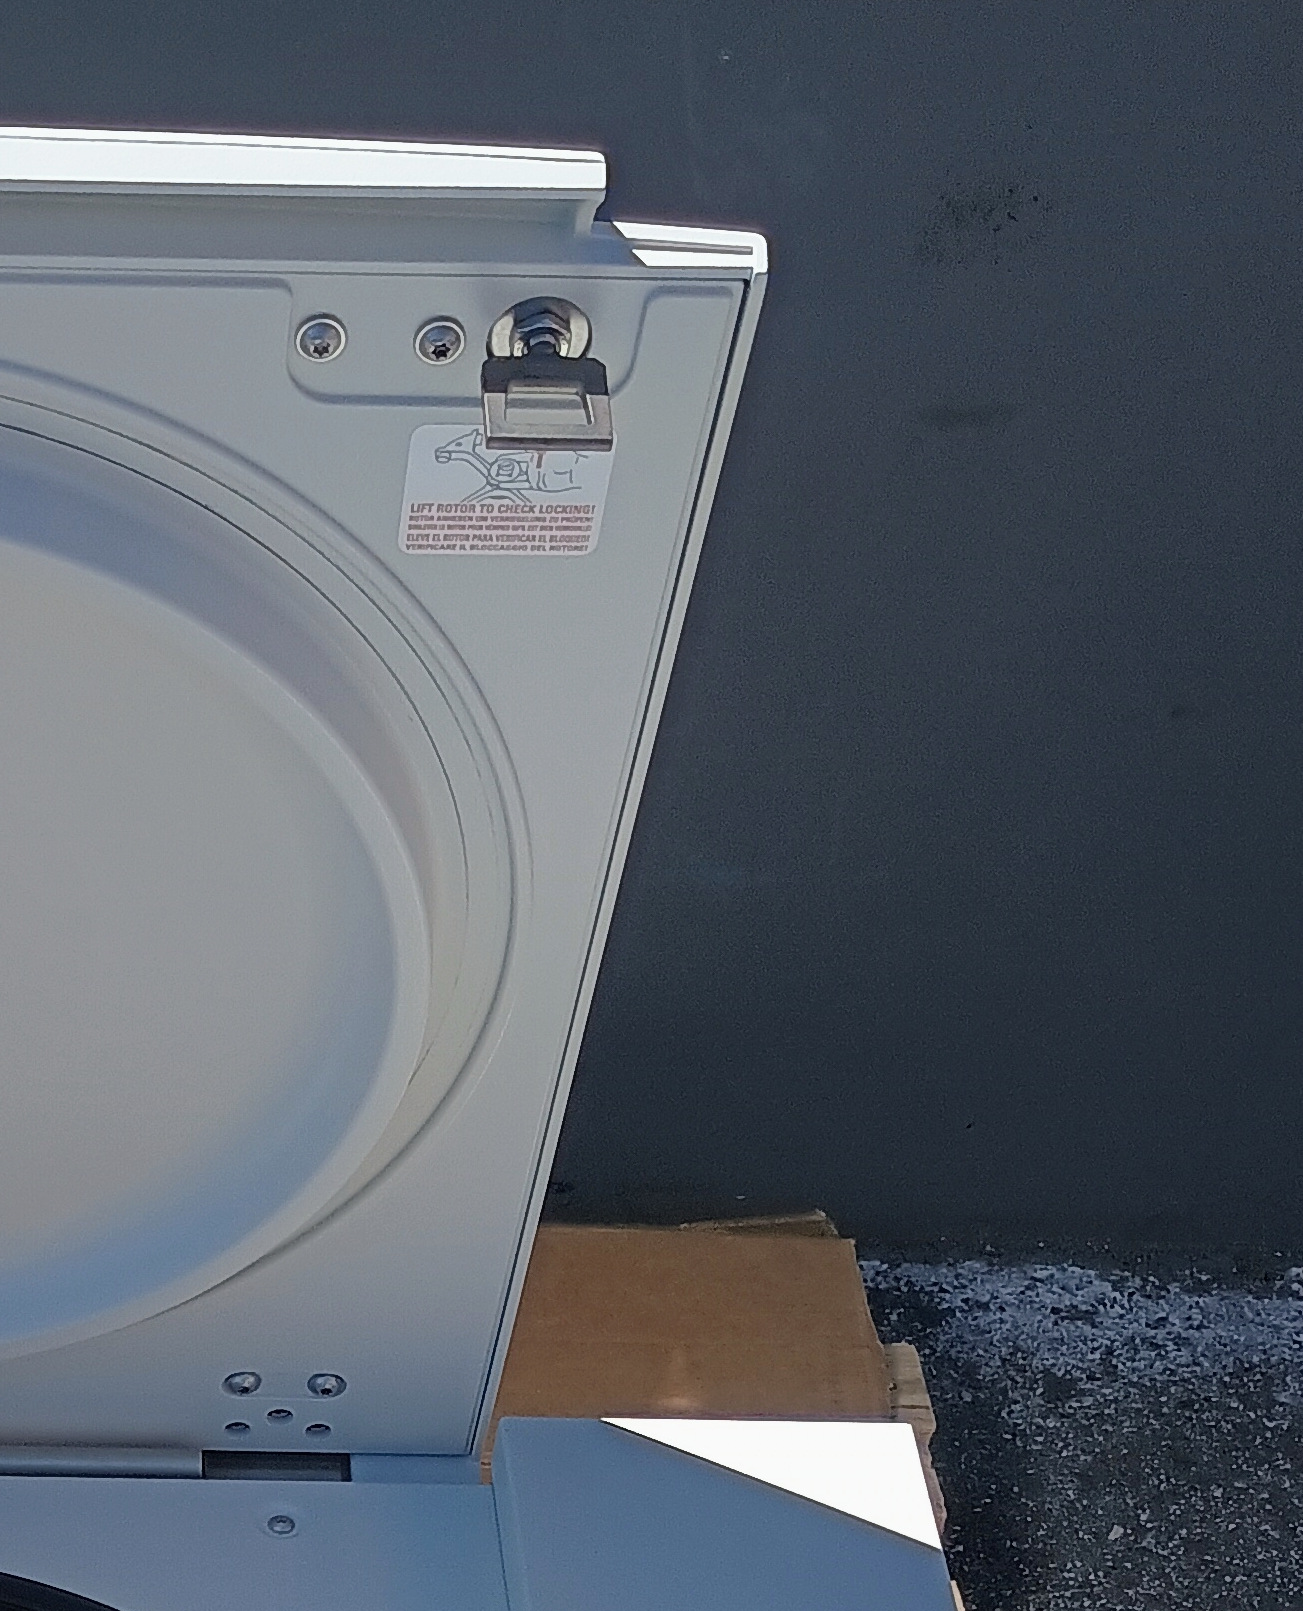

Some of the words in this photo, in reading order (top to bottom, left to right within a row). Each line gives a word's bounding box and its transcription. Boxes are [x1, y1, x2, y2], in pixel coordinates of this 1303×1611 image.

[410, 503, 435, 514] LIFT
[436, 503, 476, 514] ROTOR
[480, 503, 495, 514] TO
[497, 504, 537, 514] CHECK
[538, 504, 596, 515] LOCKING!
